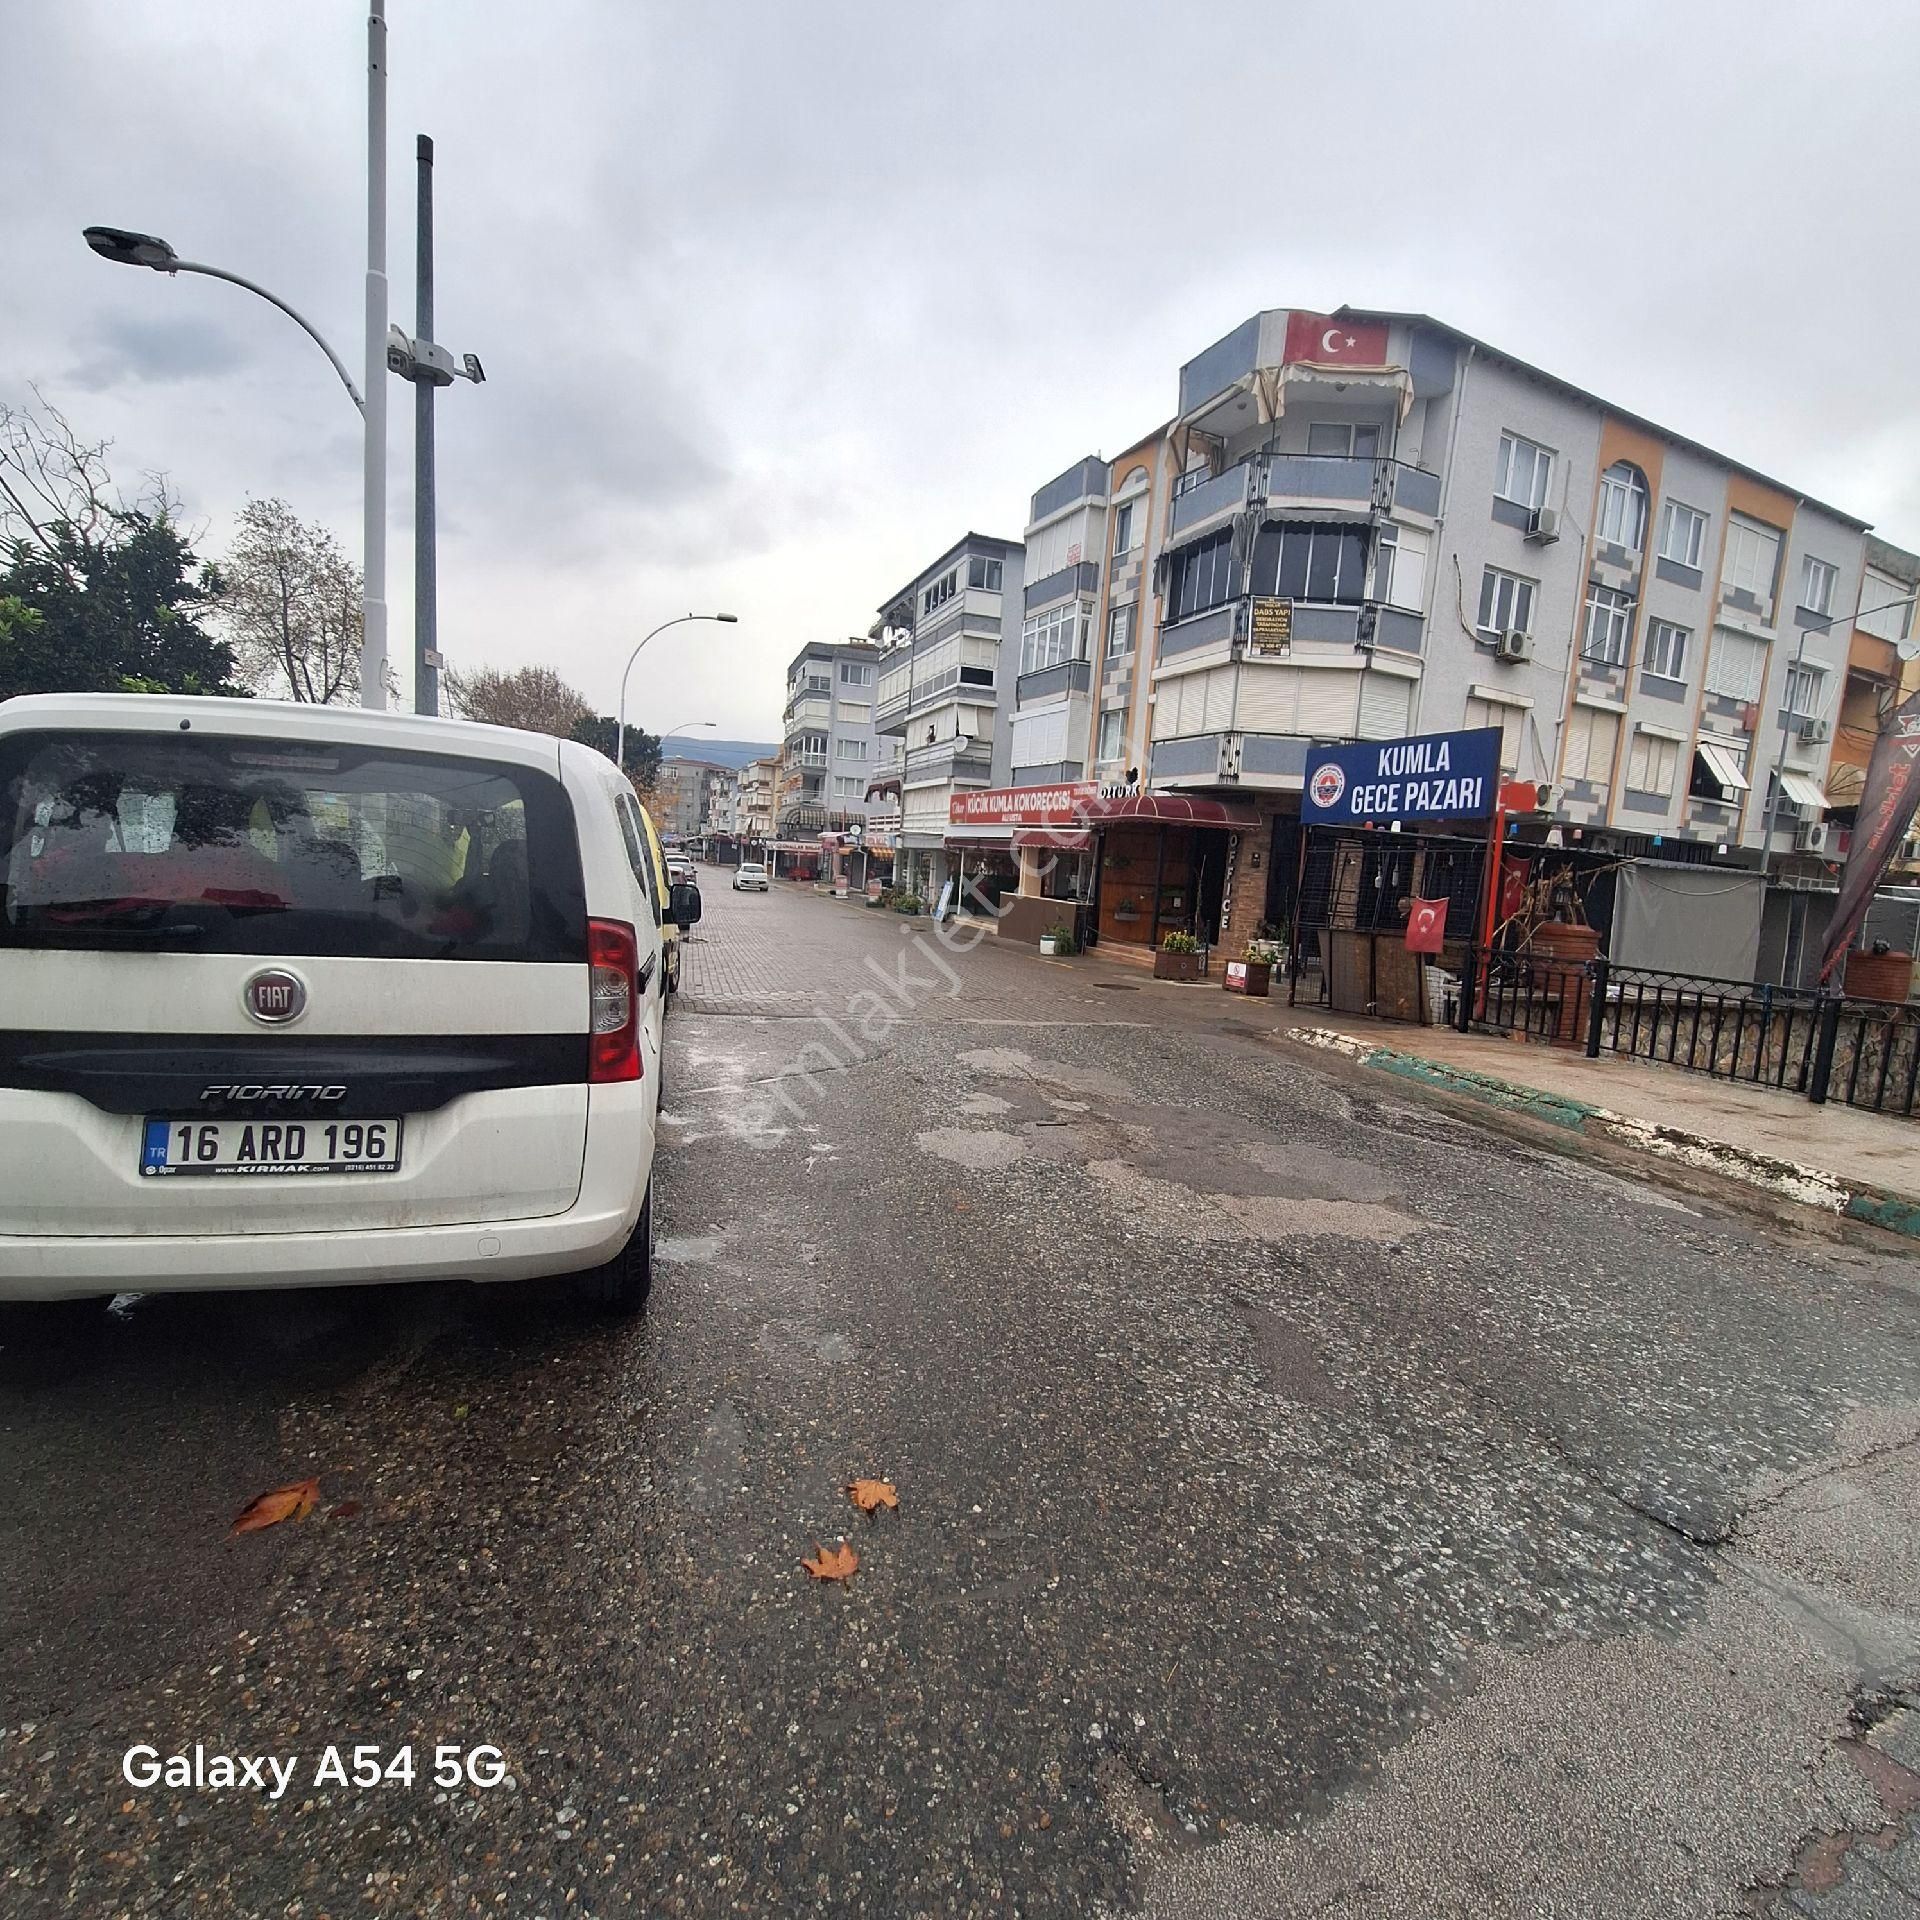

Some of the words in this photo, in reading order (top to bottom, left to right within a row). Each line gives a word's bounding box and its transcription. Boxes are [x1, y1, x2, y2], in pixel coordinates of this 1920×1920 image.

[1377, 741, 1450, 777] KUMLA
[967, 793, 989, 814] KÜÇÜK
[989, 794, 1014, 813] KUMLA
[1351, 781, 1401, 814] GECE
[1404, 777, 1483, 812] PAZARI
[1221, 834, 1238, 929] OFFICE
[258, 986, 291, 1009] FIAT
[200, 1085, 348, 1101] FIORINO
[150, 1147, 166, 1158] TR
[177, 1125, 219, 1162] 16
[237, 1125, 306, 1162] ARD
[324, 1124, 387, 1161] 196
